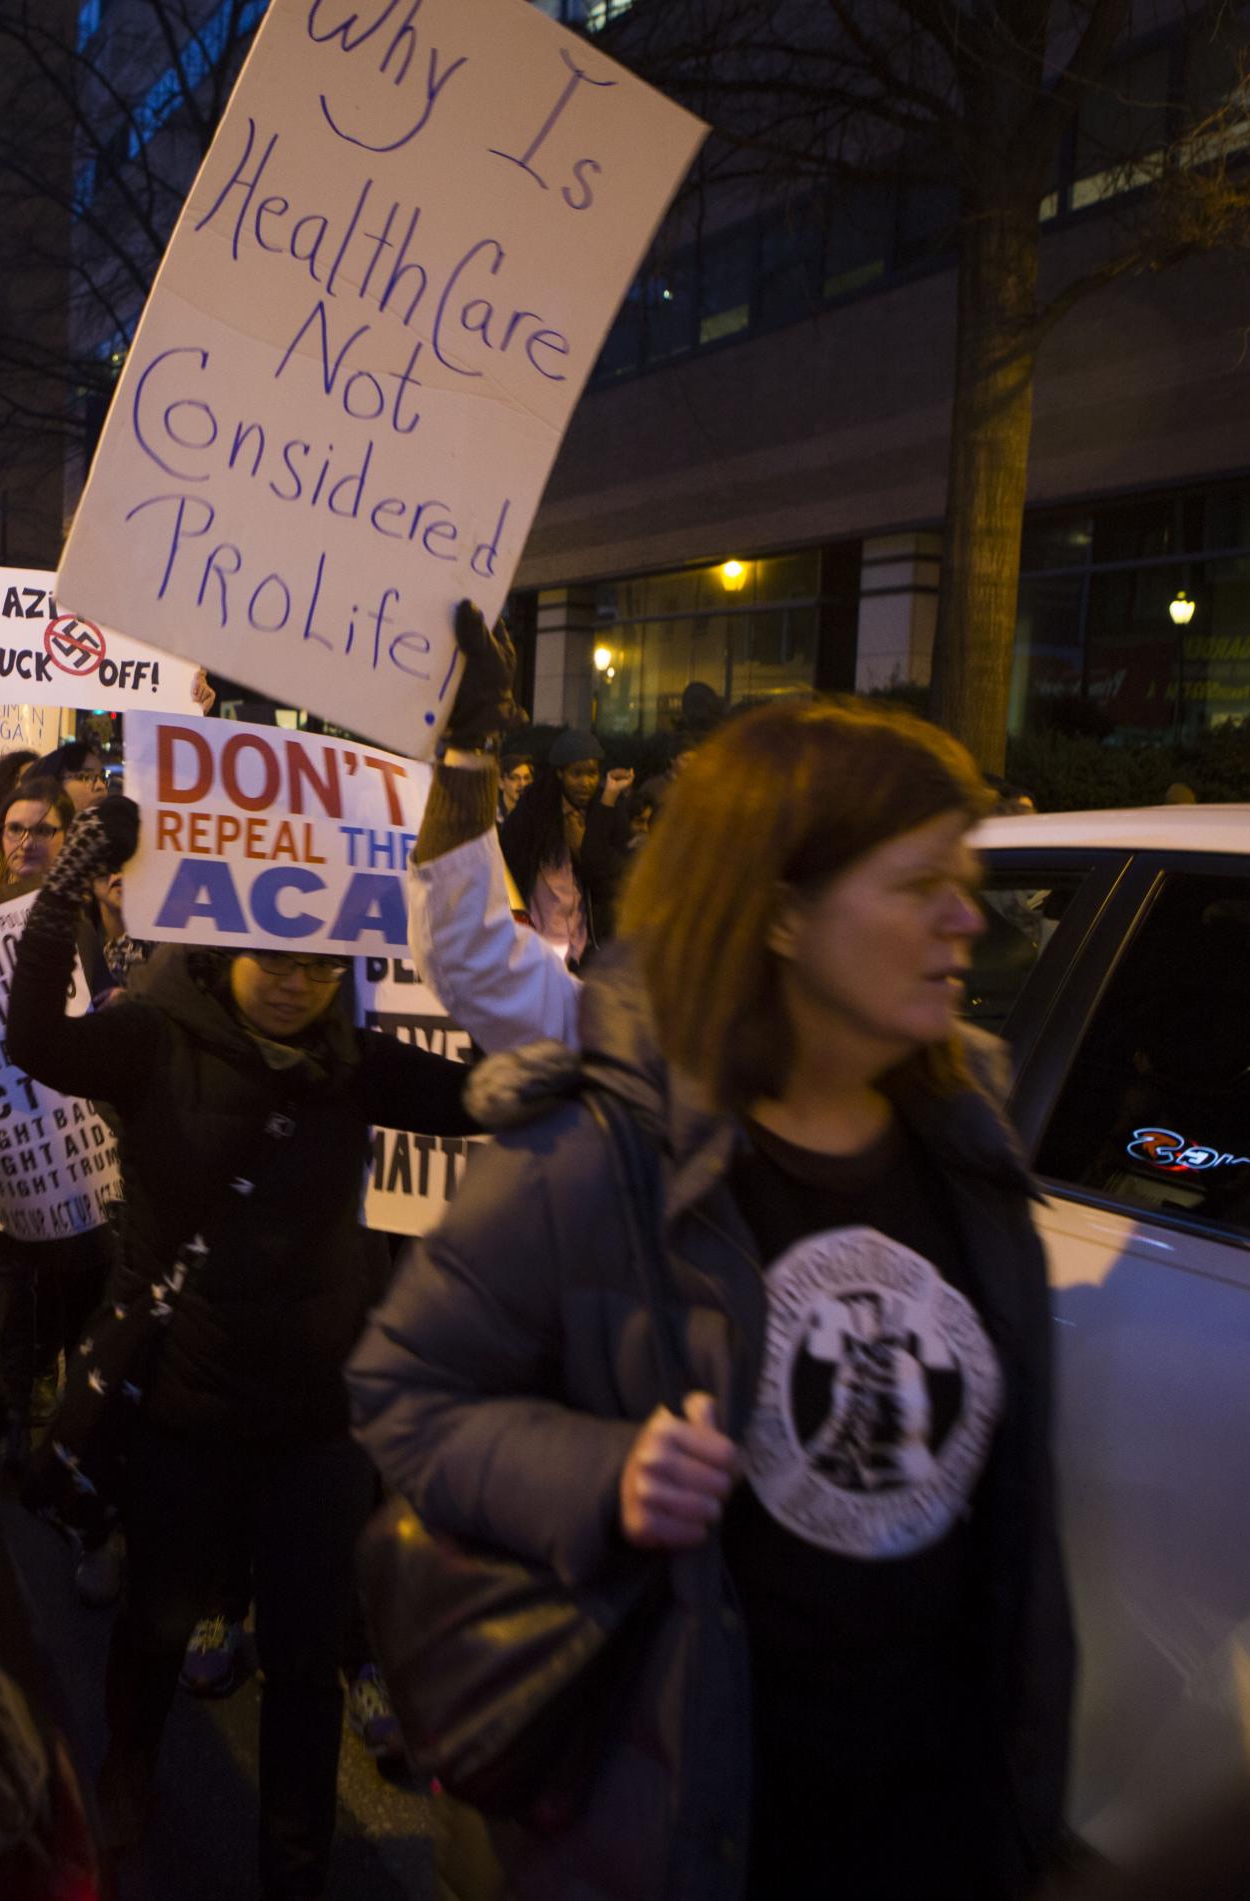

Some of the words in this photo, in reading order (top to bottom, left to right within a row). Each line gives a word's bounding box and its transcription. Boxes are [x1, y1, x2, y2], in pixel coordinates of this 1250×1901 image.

[305, 0, 467, 152] Why
[276, 300, 421, 434] Not
[134, 347, 510, 577] Considered
[98, 659, 160, 694] OFF!
[156, 725, 408, 827] DON'T
[156, 809, 327, 864] REPEAL
[154, 858, 408, 946] ACA
